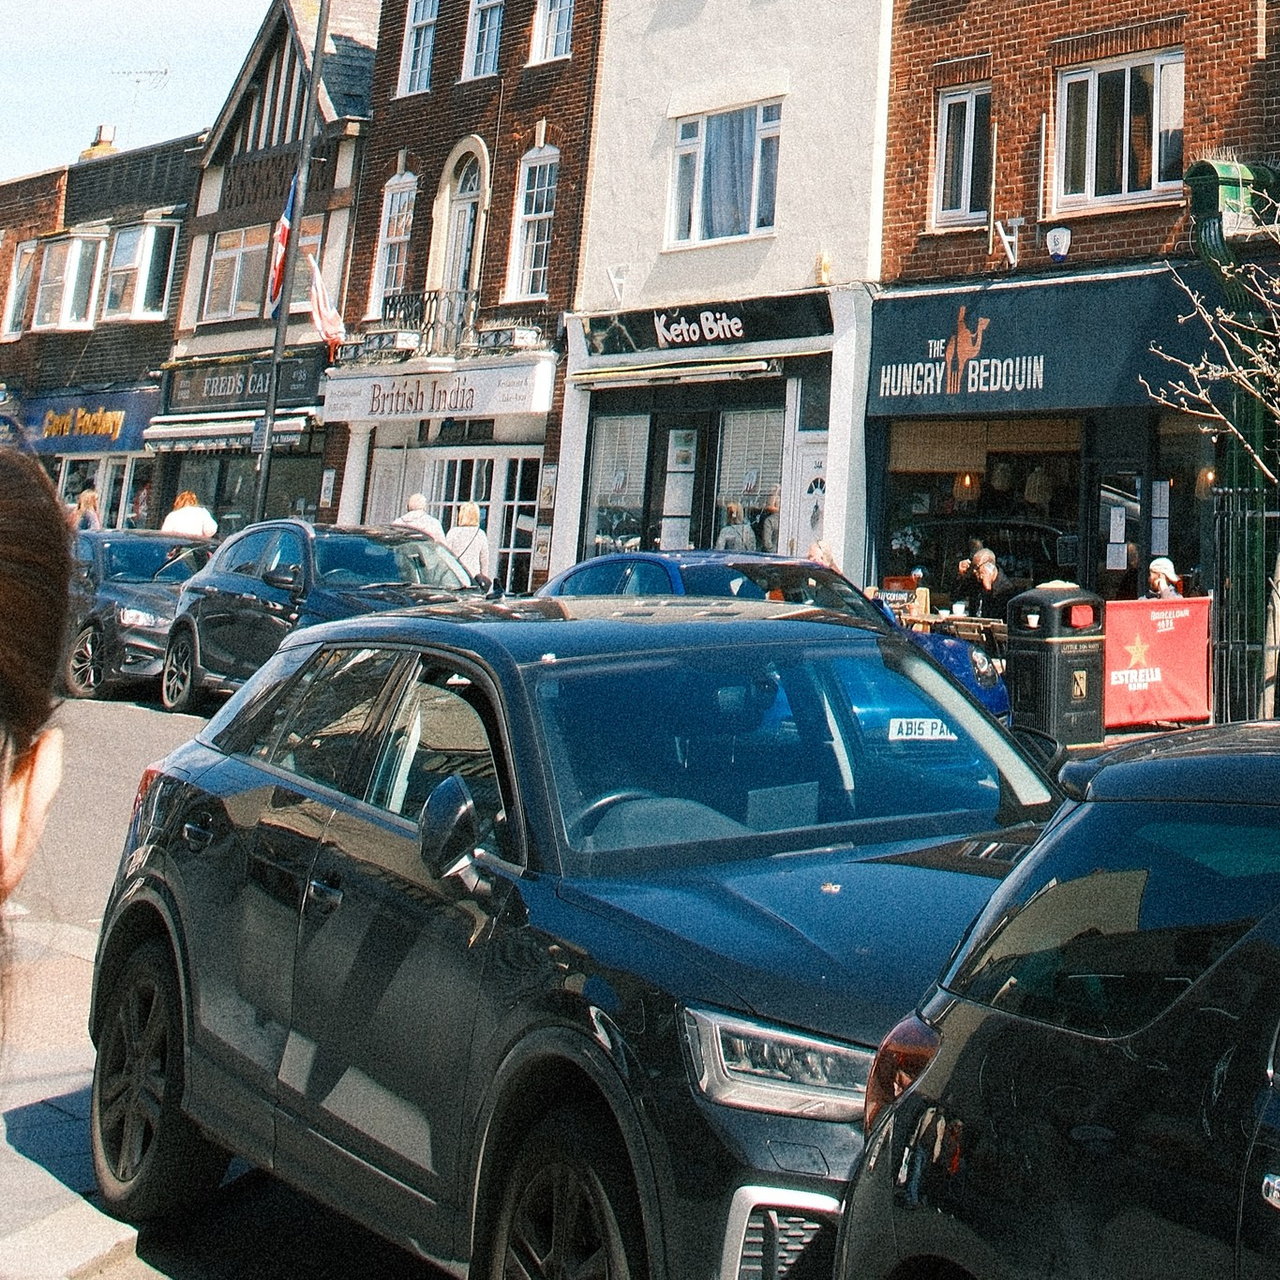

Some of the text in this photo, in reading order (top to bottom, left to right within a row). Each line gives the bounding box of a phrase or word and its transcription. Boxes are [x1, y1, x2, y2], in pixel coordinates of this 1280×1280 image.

[654, 310, 744, 347] Keto Bite
[928, 339, 946, 358] THE
[203, 372, 245, 397] FRED'S
[880, 355, 1045, 397] HUNGRY BEDOUIN
[369, 376, 476, 415] British India
[74, 406, 126, 441] Factory
[1110, 667, 1161, 686] ESTRELLA
